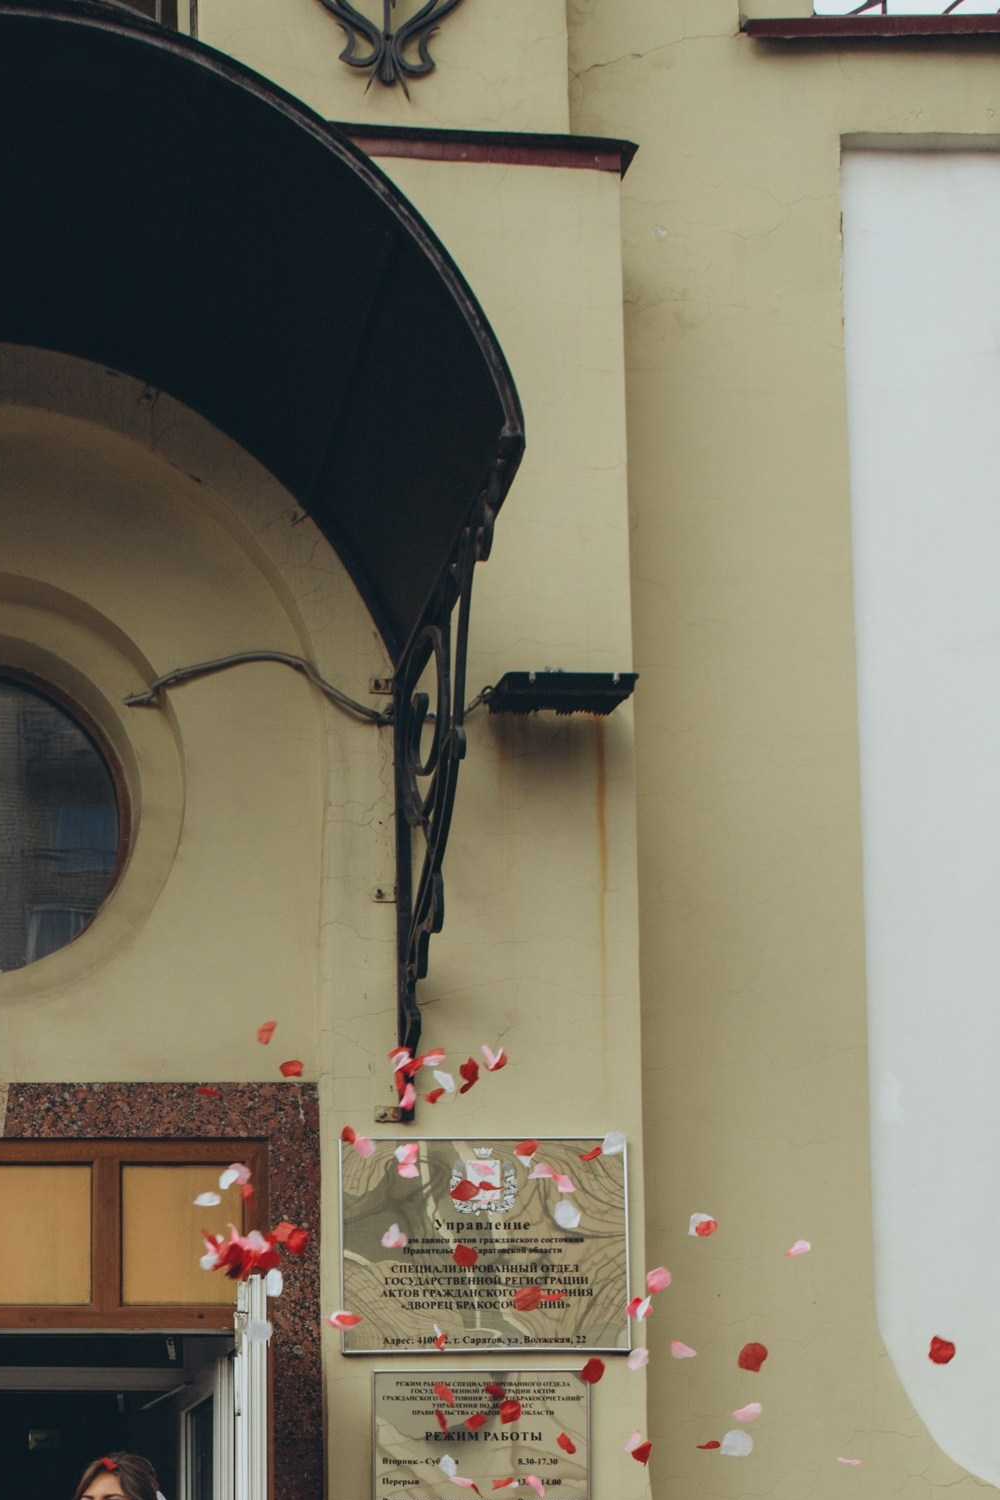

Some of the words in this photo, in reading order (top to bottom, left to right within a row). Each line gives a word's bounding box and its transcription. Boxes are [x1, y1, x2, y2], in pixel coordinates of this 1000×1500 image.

[434, 1218, 530, 1234] Управление
[479, 1237, 539, 1246] гражданского
[528, 1246, 563, 1254] области
[540, 1263, 579, 1274] ОТДЕЛ
[384, 1276, 502, 1287] ГОСУДАРСТВЕННОЙ
[504, 1276, 589, 1286] РЕГИСТРАЦИИ
[380, 1288, 420, 1298] АКТОВ
[422, 1288, 517, 1299] ГРАЖДАНСКОГО
[382, 1336, 415, 1347] Адрес:
[462, 1335, 506, 1346] Саратов,
[524, 1335, 574, 1345] Волжская,
[575, 1335, 587, 1344] 22
[424, 1431, 480, 1442] РЕЖИМ
[483, 1431, 543, 1442] РАБОТЫ
[382, 1457, 419, 1466] Вторник
[517, 1457, 559, 1466] 8.30-17.30
[382, 1477, 420, 1487] Перерыв
